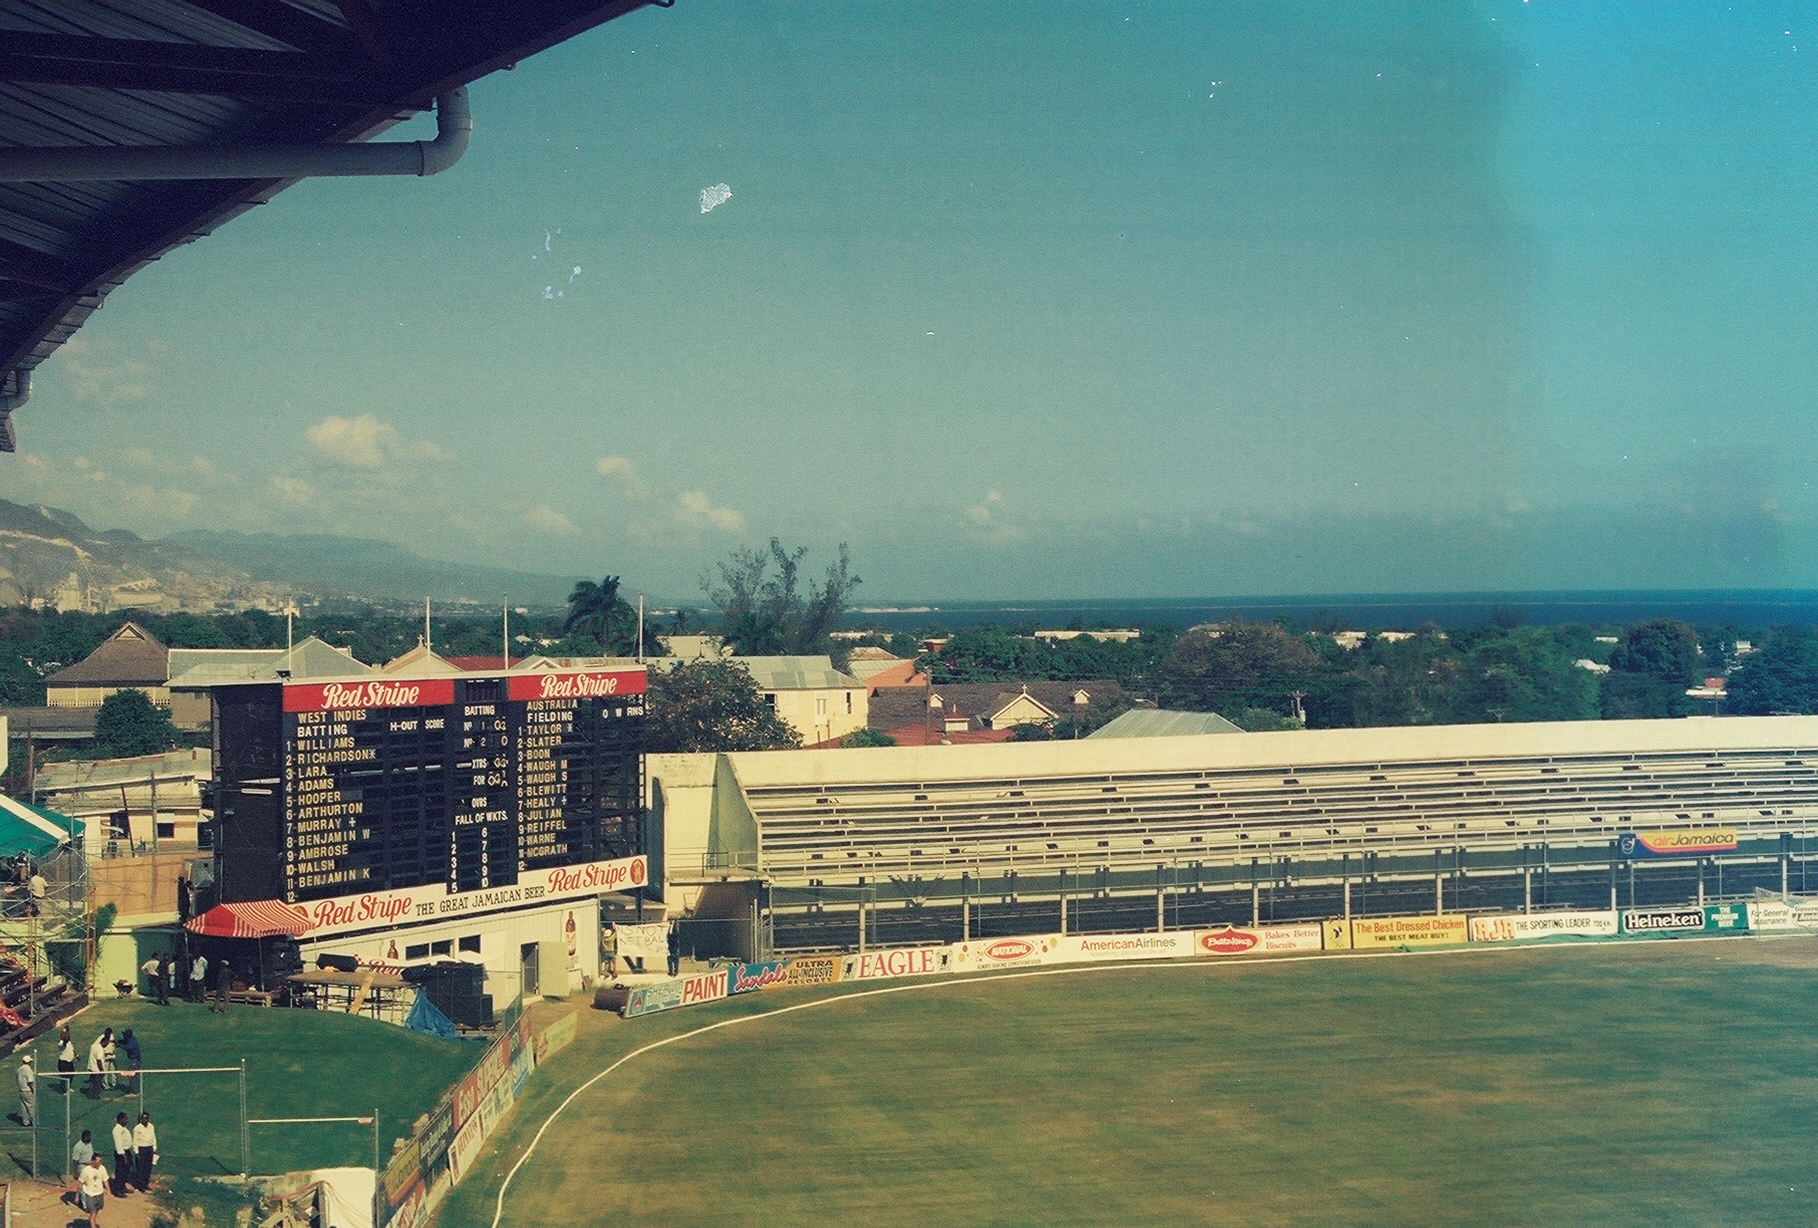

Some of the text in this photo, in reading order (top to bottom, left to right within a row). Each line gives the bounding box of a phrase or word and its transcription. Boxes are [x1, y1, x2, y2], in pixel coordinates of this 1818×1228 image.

[539, 674, 617, 698] Red Stripe
[321, 681, 420, 709] Red Stripe
[464, 705, 496, 716] BATTING
[526, 699, 578, 711] AUSTRALIA
[297, 709, 367, 723] WEST INDIES
[527, 711, 573, 723] FIELDING
[626, 706, 644, 717] RNS
[297, 724, 348, 737] BATTING
[390, 718, 445, 731] H-OUT SCORE
[561, 771, 568, 781] S
[455, 813, 474, 826] FALL
[475, 812, 485, 823] OF
[362, 828, 370, 840] W
[451, 827, 488, 842] 1 6
[450, 840, 488, 854] 2 7
[450, 852, 488, 869] 3 8
[362, 868, 370, 879] K
[450, 865, 488, 880] 4 9
[451, 876, 489, 893] 5 10
[314, 863, 627, 928] Red Stripe THE GREAT JAMAICAN BEER Red Stripe
[1628, 911, 1701, 928] Heineken
[1763, 908, 1789, 917] General
[1355, 919, 1465, 933] The Best Dressed Chicken
[1475, 919, 1516, 941] RJR
[1516, 921, 1528, 931] THE
[1530, 919, 1564, 930] SPORTING
[1565, 918, 1591, 928] LEADER
[1265, 929, 1320, 939] Bakes Better
[991, 945, 1028, 957] NATIONAL
[1266, 941, 1297, 949] Biscuits
[796, 960, 833, 968] ULTRA
[859, 949, 935, 979] EAGLE
[735, 963, 787, 992] Sandals
[682, 973, 727, 1004] PAINT
